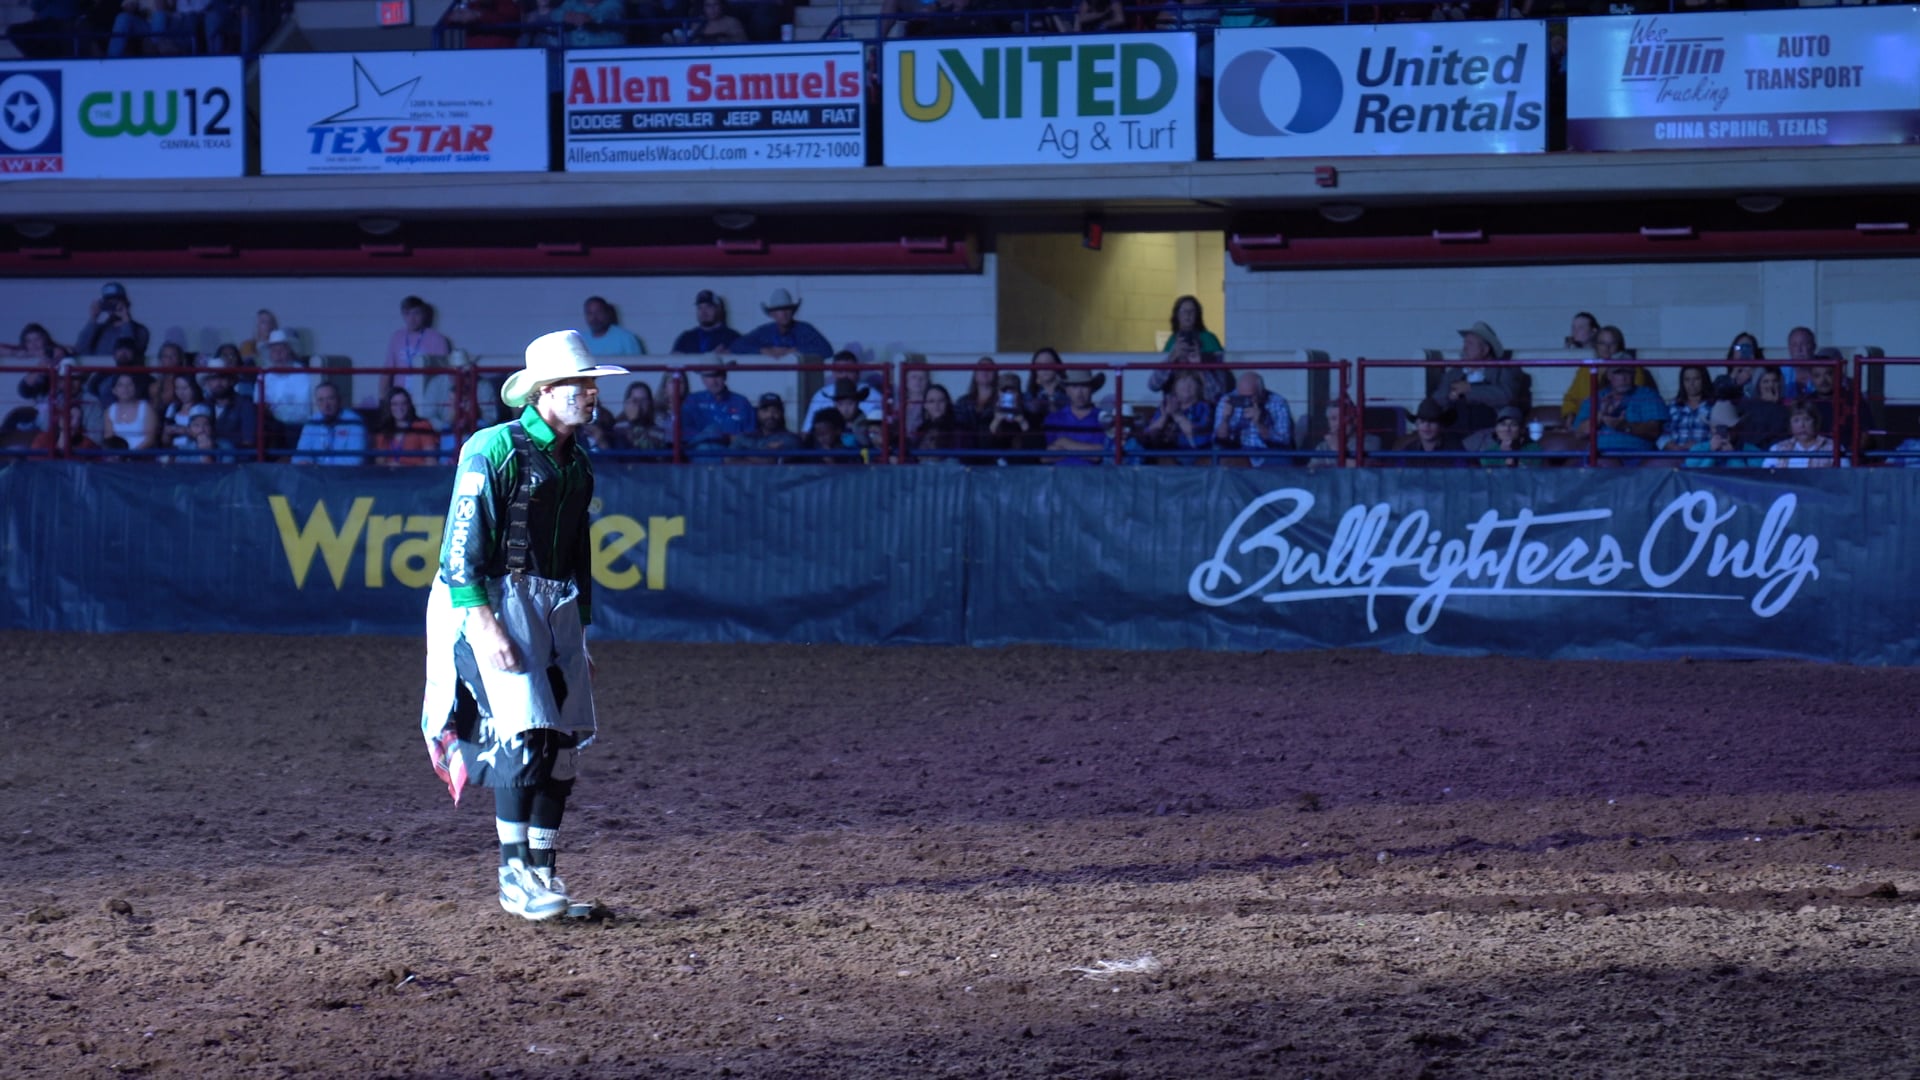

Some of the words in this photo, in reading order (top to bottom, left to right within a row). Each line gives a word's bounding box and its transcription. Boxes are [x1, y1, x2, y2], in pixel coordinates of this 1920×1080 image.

[1630, 17, 1668, 44] Wes
[1777, 34, 1831, 58] AUTO
[1356, 43, 1528, 88] United
[1622, 43, 1725, 76] Hillin
[567, 66, 671, 105] Allen
[686, 60, 860, 102] Samuels
[898, 42, 1179, 123] UNITED
[1655, 74, 1730, 111] Trucking
[1745, 65, 1864, 90] TRANSPORT
[571, 114, 622, 129] DODGE
[632, 112, 713, 127] CHRYSLER
[723, 110, 761, 126] JEEP
[771, 109, 809, 125] RAM
[821, 107, 856, 123] FIAT
[1354, 91, 1542, 134] Rentals
[160, 139, 200, 149] CENTRAL
[203, 138, 232, 149] TEXAS
[306, 124, 494, 154] TEXSTAR
[1037, 122, 1079, 159] Ag
[1089, 121, 1112, 150] &
[1119, 119, 1177, 150] Turf
[1655, 121, 1705, 139] CHINA
[1708, 119, 1774, 139] SPRING,
[1778, 118, 1828, 136] TEXAS
[0, 158, 57, 172] WTX
[385, 153, 451, 165] equipment
[455, 151, 490, 162] sales
[567, 143, 747, 163] AllenSamuelsWacoDCJ.com
[766, 141, 860, 159] 254-772-1000
[268, 495, 686, 591] Wraer
[449, 521, 471, 585] HOOEY
[1188, 487, 1633, 634] Bullfighters
[1639, 489, 1821, 618] Only
